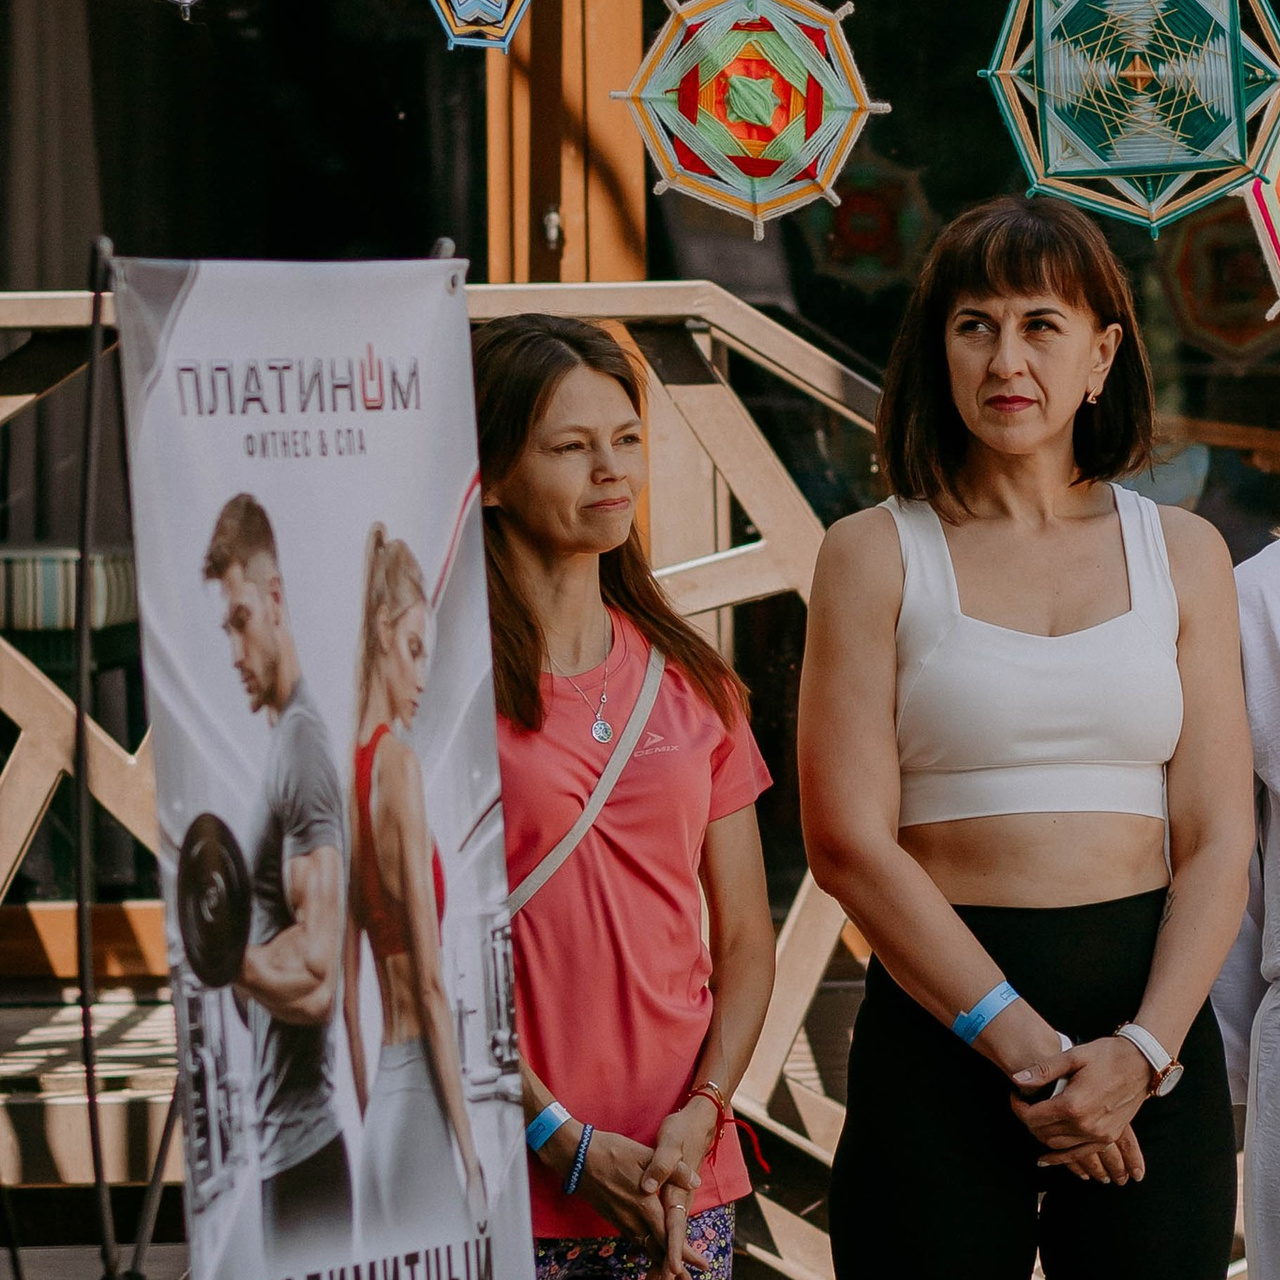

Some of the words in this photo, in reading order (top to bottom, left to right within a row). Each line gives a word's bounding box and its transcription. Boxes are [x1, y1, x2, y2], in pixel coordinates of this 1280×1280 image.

[244, 429, 312, 458] ФИТНЕС
[336, 428, 366, 456] СПА
[633, 745, 679, 757] DEMIX
